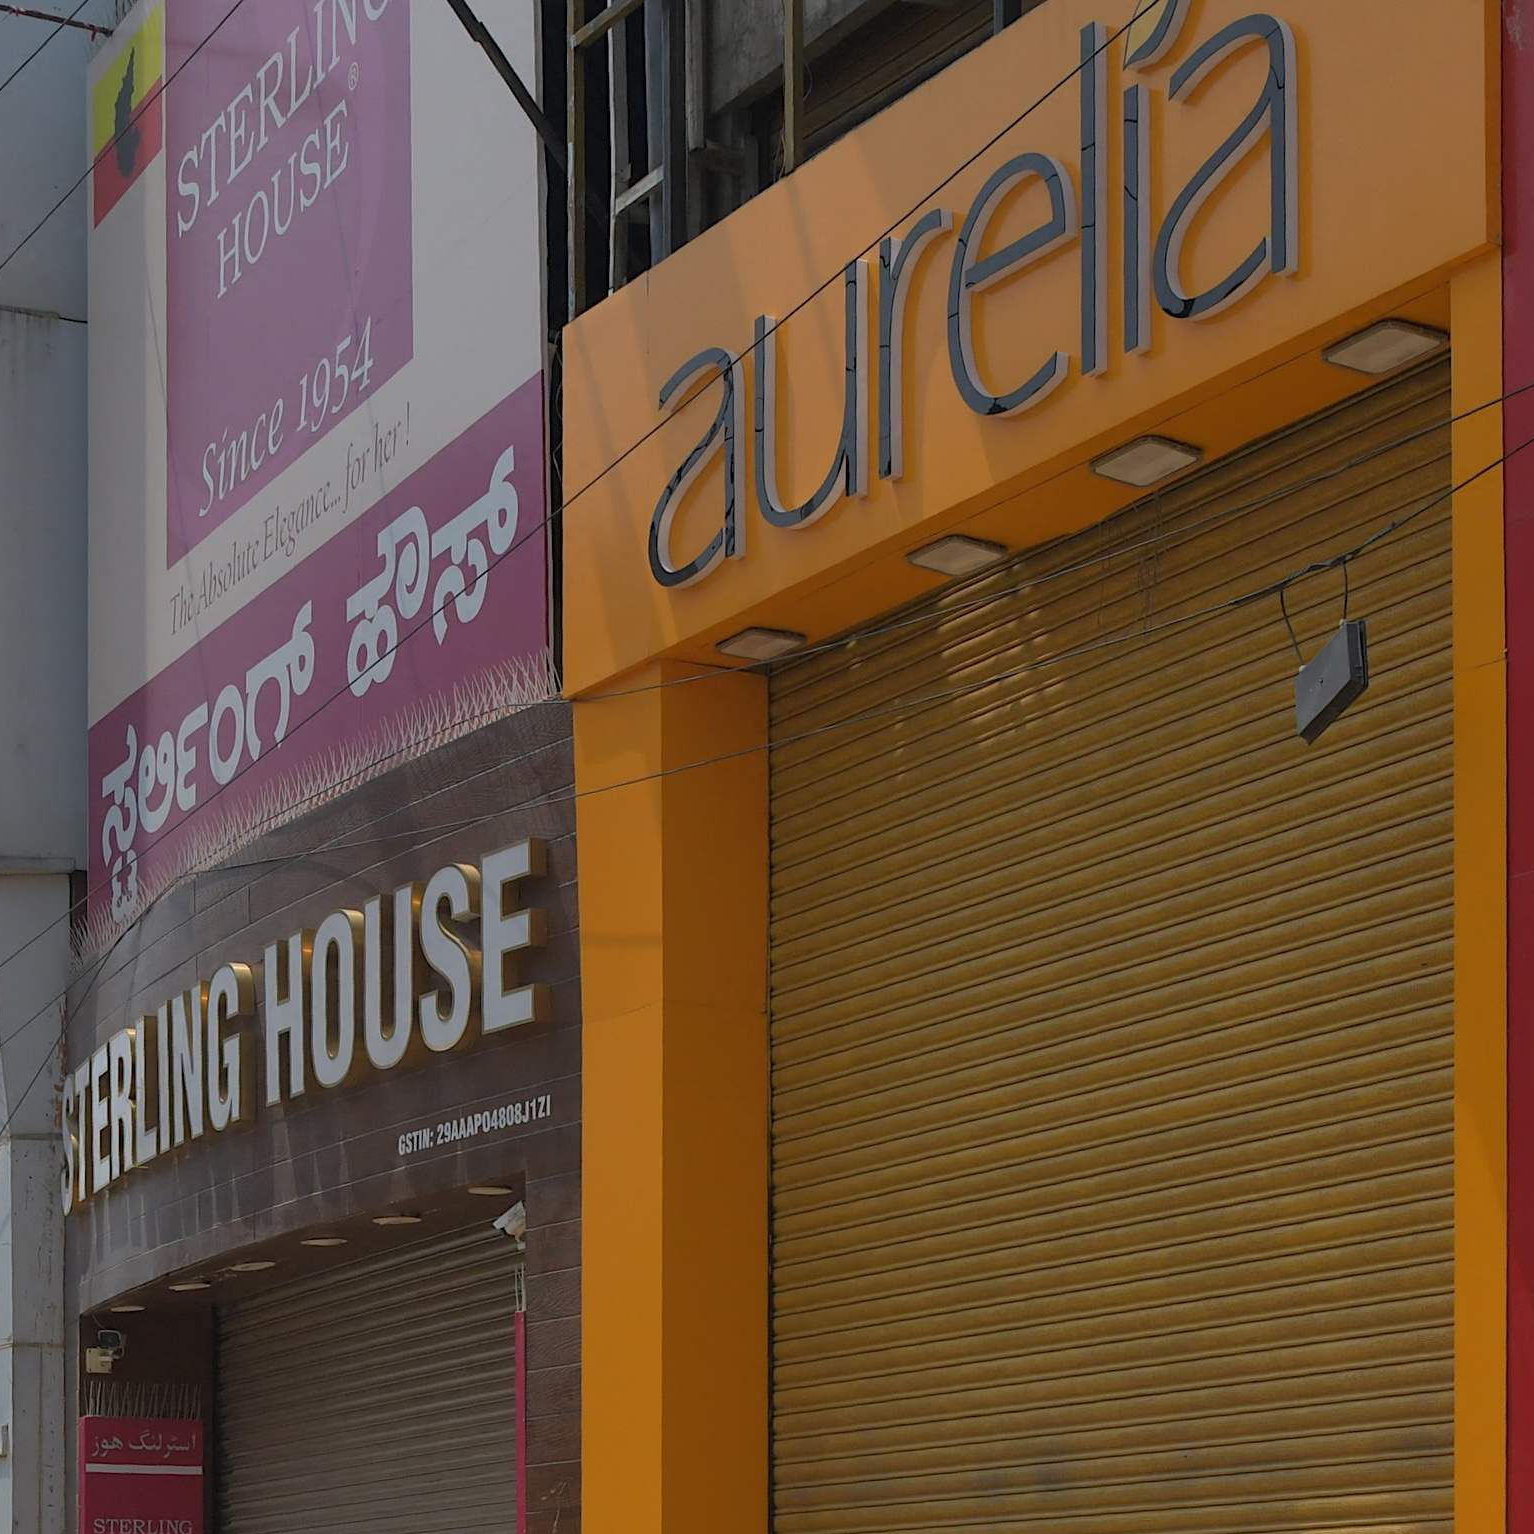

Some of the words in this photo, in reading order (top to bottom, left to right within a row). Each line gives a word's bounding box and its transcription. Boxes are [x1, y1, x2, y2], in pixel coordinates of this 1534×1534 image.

[217, 104, 349, 299] HOUSE
[647, 2, 1299, 588] aurelia
[199, 397, 285, 518] Since
[296, 316, 374, 433] 1954
[197, 543, 262, 612] Absolute
[343, 442, 370, 494] for
[61, 962, 253, 1216] STERLING
[265, 837, 549, 1108] HOUSE
[398, 1127, 434, 1156] GSTIN:
